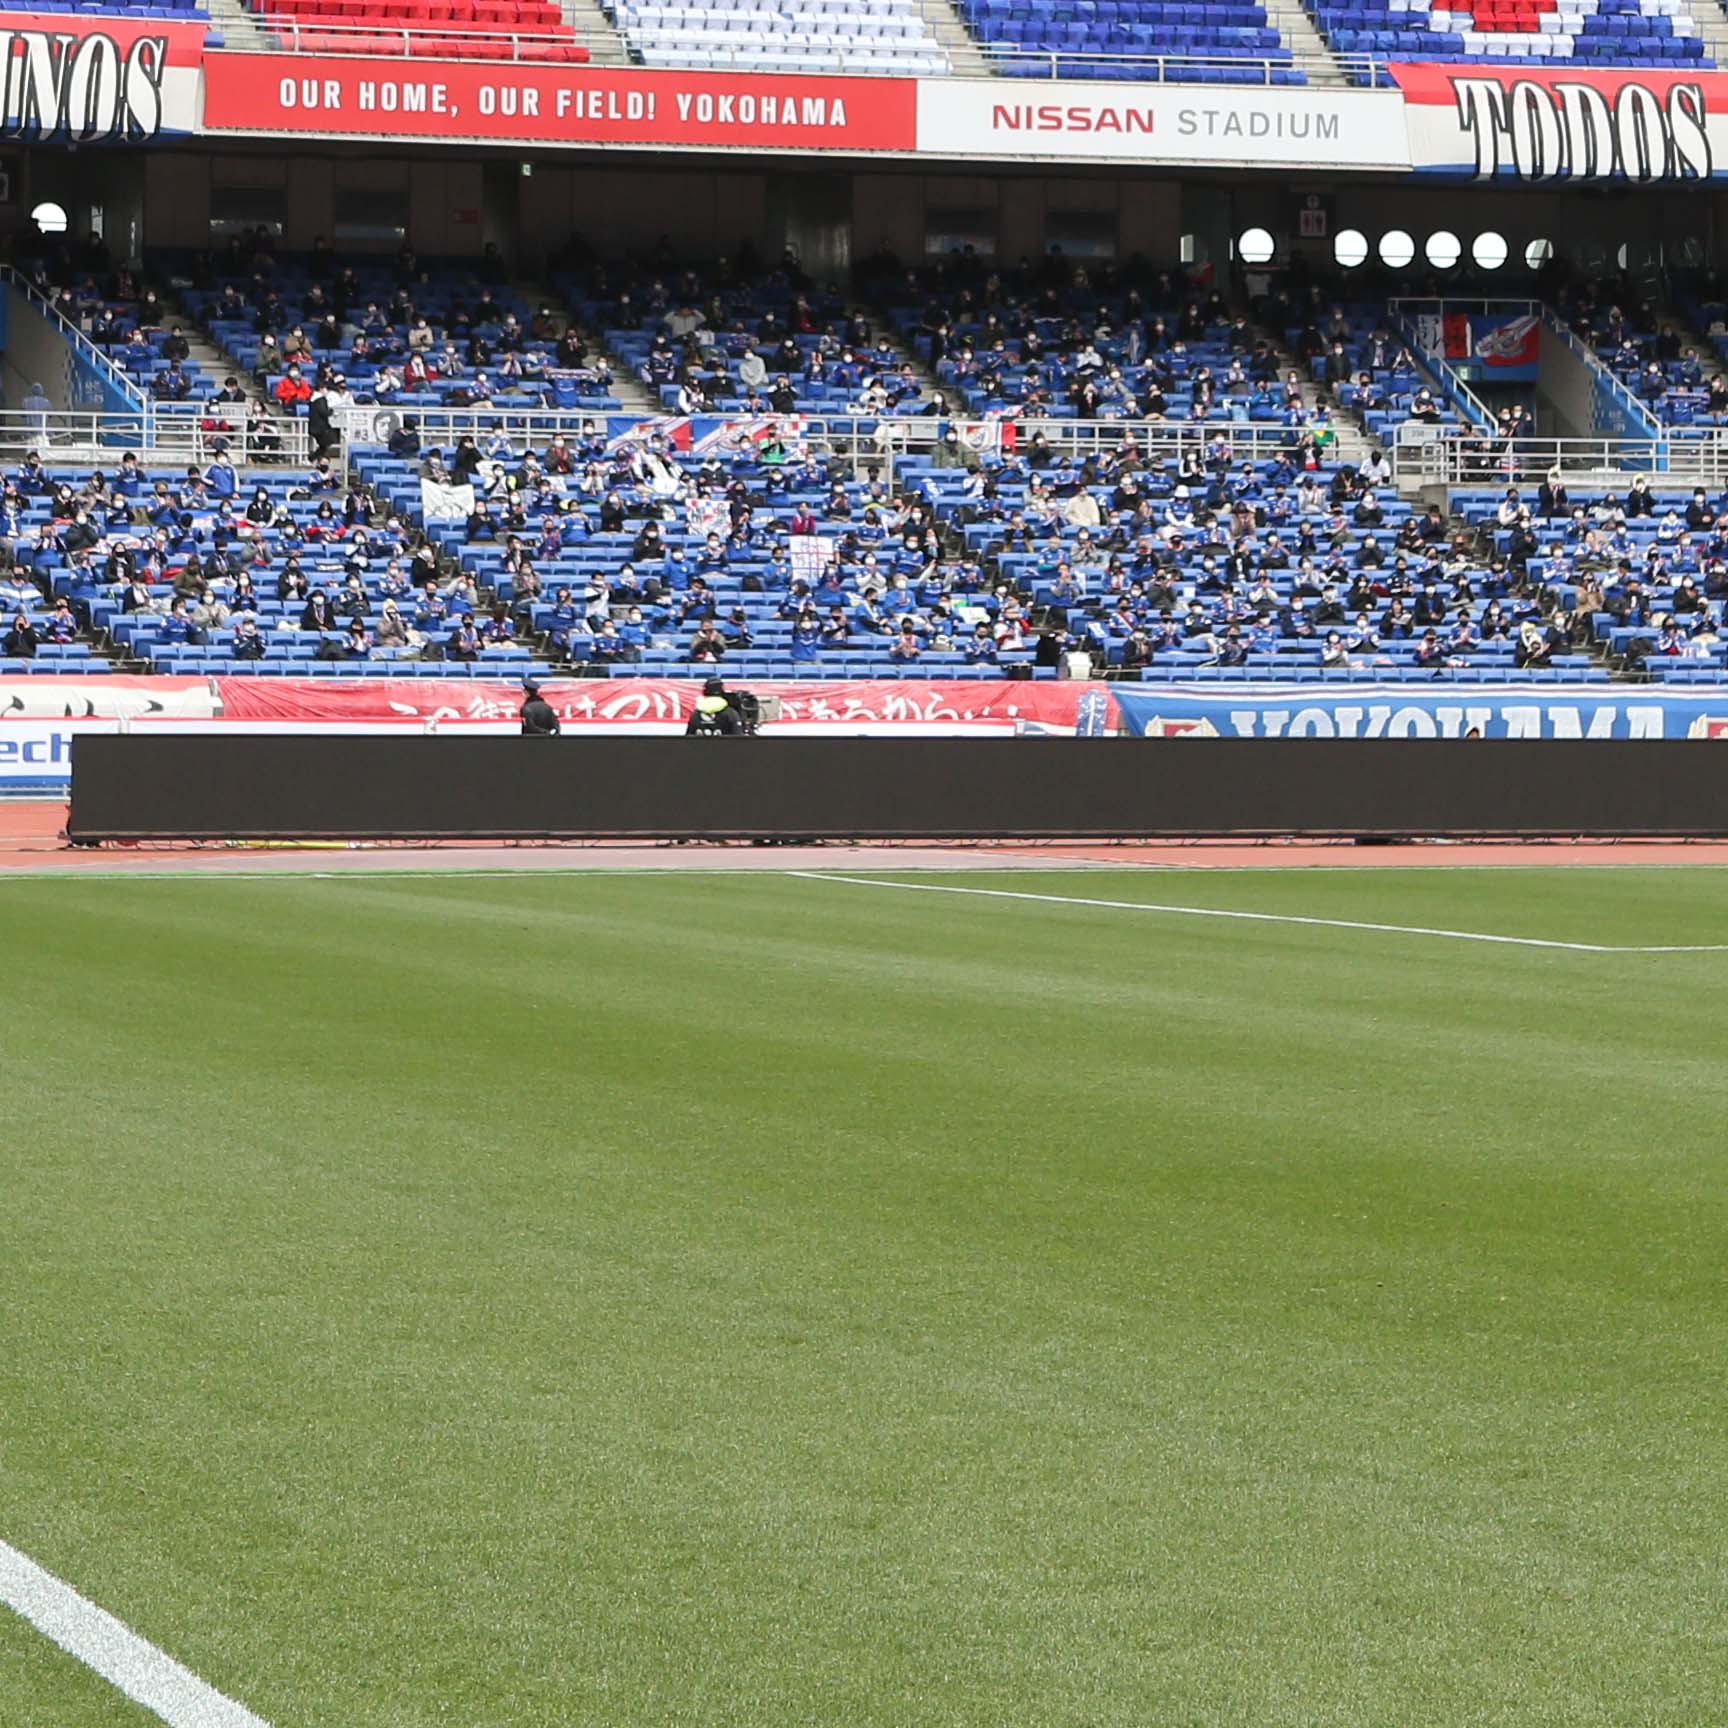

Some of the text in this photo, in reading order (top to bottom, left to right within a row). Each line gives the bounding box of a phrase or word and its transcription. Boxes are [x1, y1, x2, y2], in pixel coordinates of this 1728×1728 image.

[279, 77, 847, 127] OUR HOME, OUR FIELD! YOKOHAMA
[991, 104, 1340, 140] NISSAN STADIUM
[1447, 77, 1714, 188] TODOS
